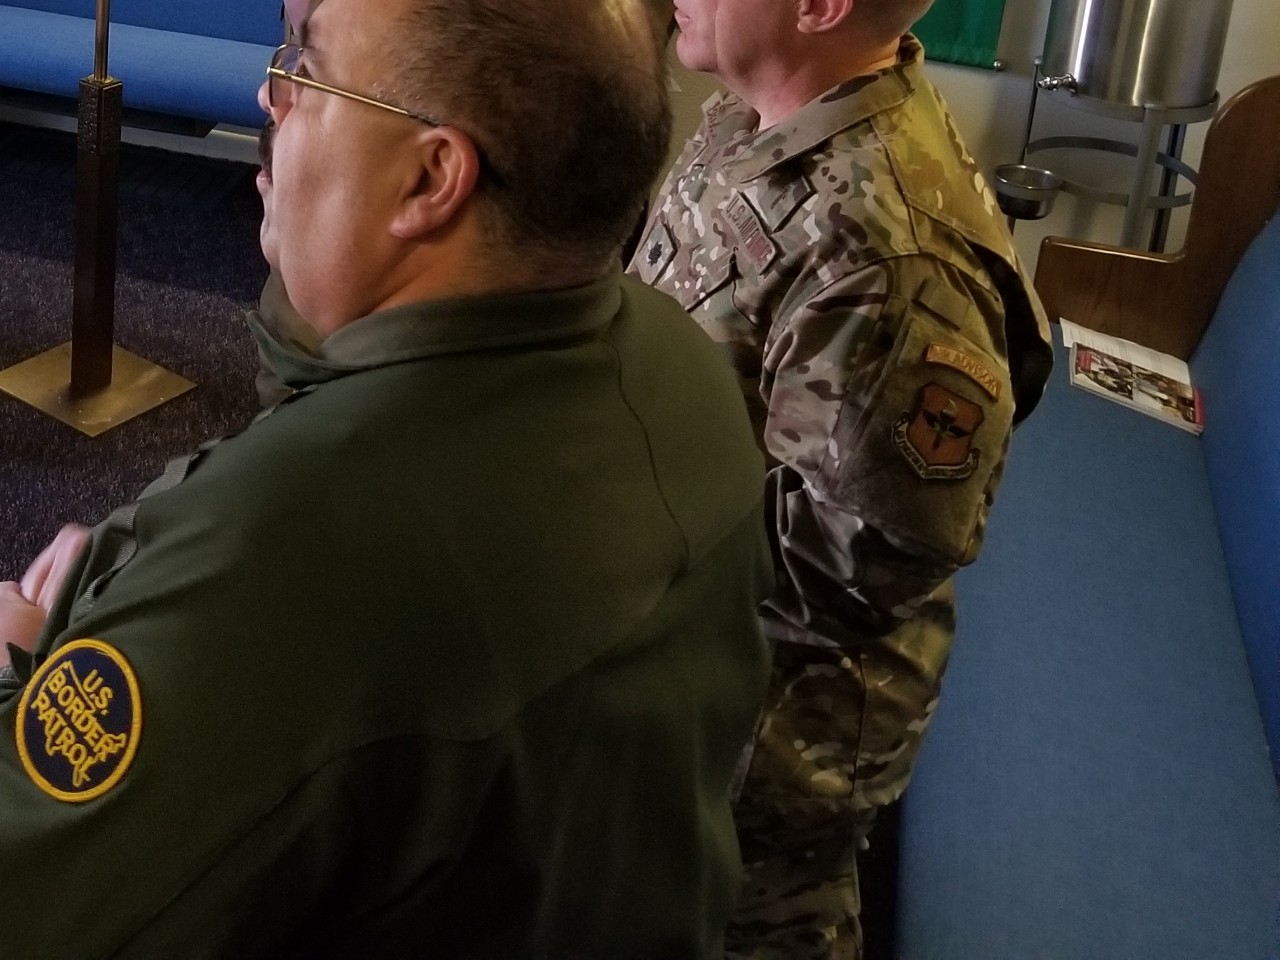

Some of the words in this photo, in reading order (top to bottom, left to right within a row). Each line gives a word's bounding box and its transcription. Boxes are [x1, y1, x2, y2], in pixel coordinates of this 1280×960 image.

[31, 691, 93, 781] PATROL
[47, 671, 114, 762] BORDER
[83, 669, 113, 715] U.S.
